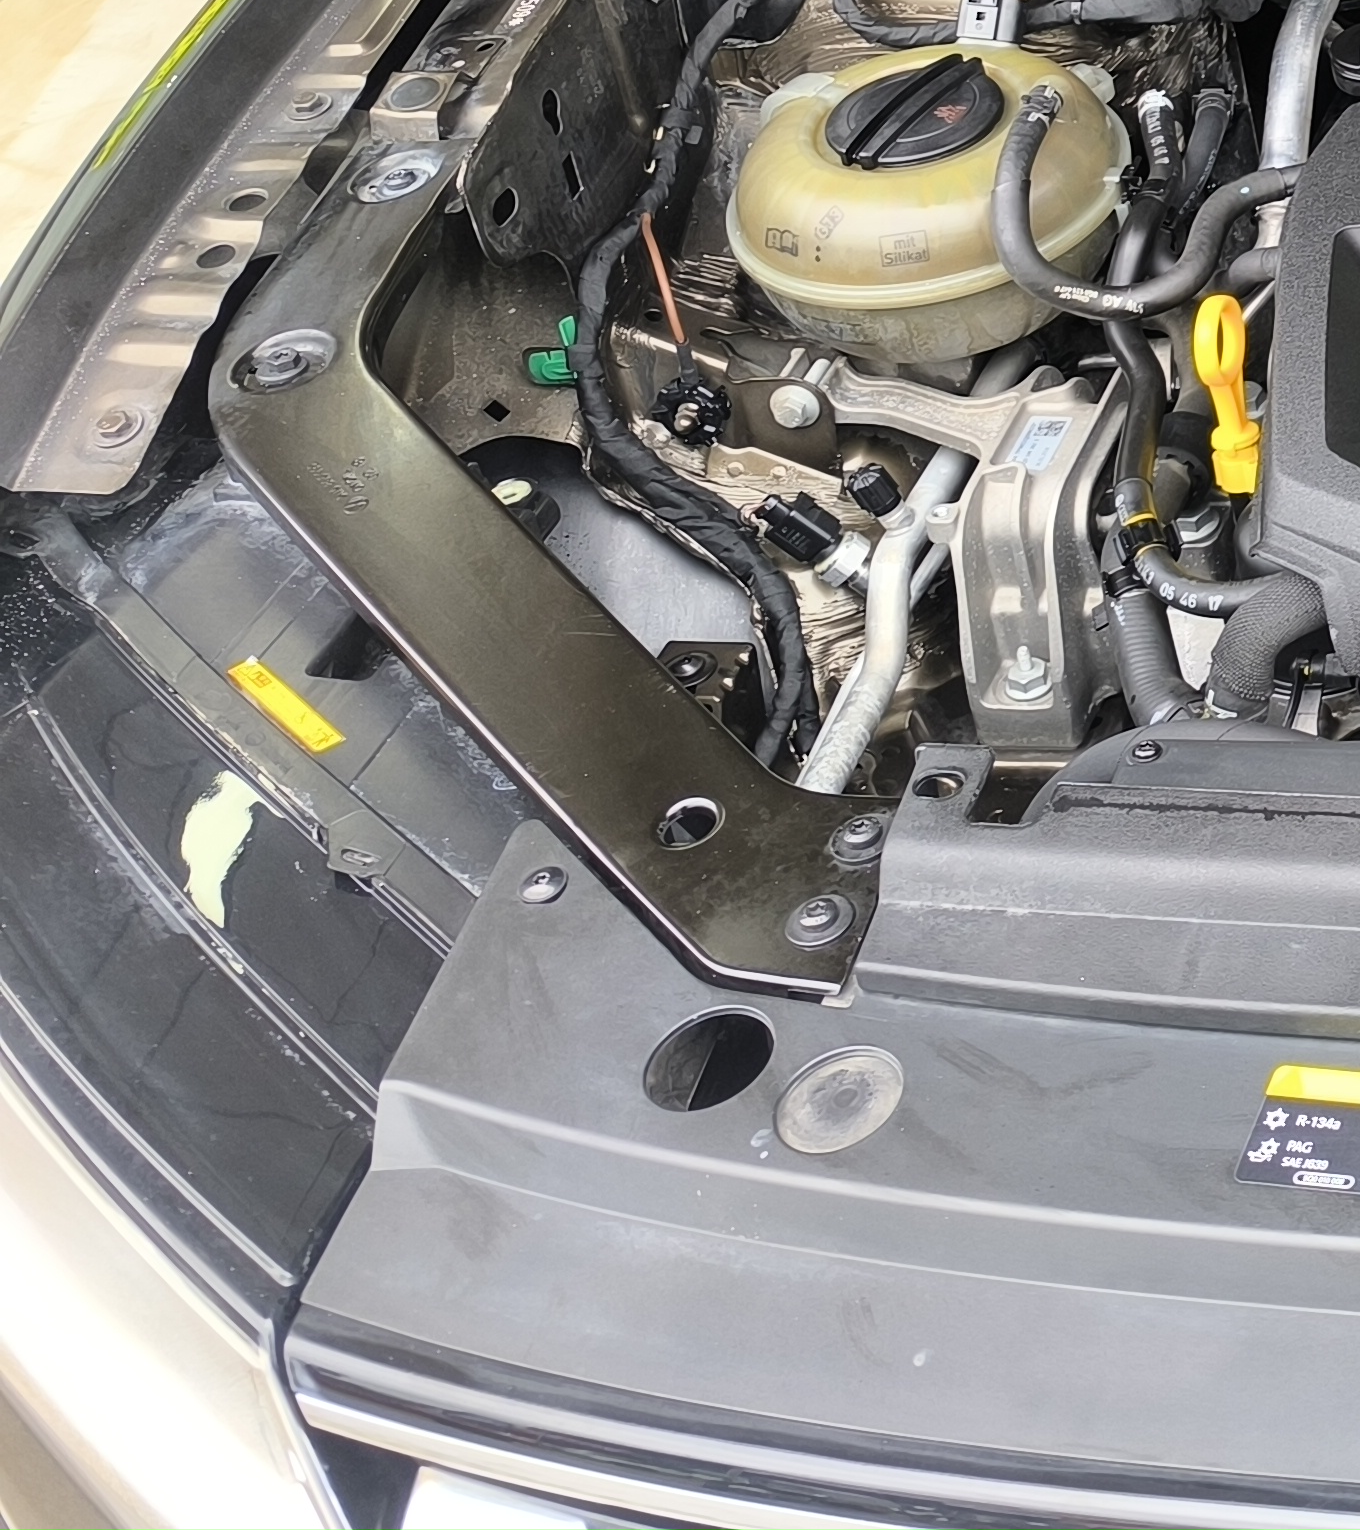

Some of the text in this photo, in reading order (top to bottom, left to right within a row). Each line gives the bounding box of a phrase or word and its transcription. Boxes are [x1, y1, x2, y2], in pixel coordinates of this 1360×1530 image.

[893, 234, 917, 250] mit
[883, 247, 928, 265] Silikat
[1159, 582, 1224, 612] 05 46 17
[1294, 1114, 1341, 1130] R-134a
[1285, 1140, 1314, 1154] PAG
[1280, 1156, 1302, 1169] SAE
